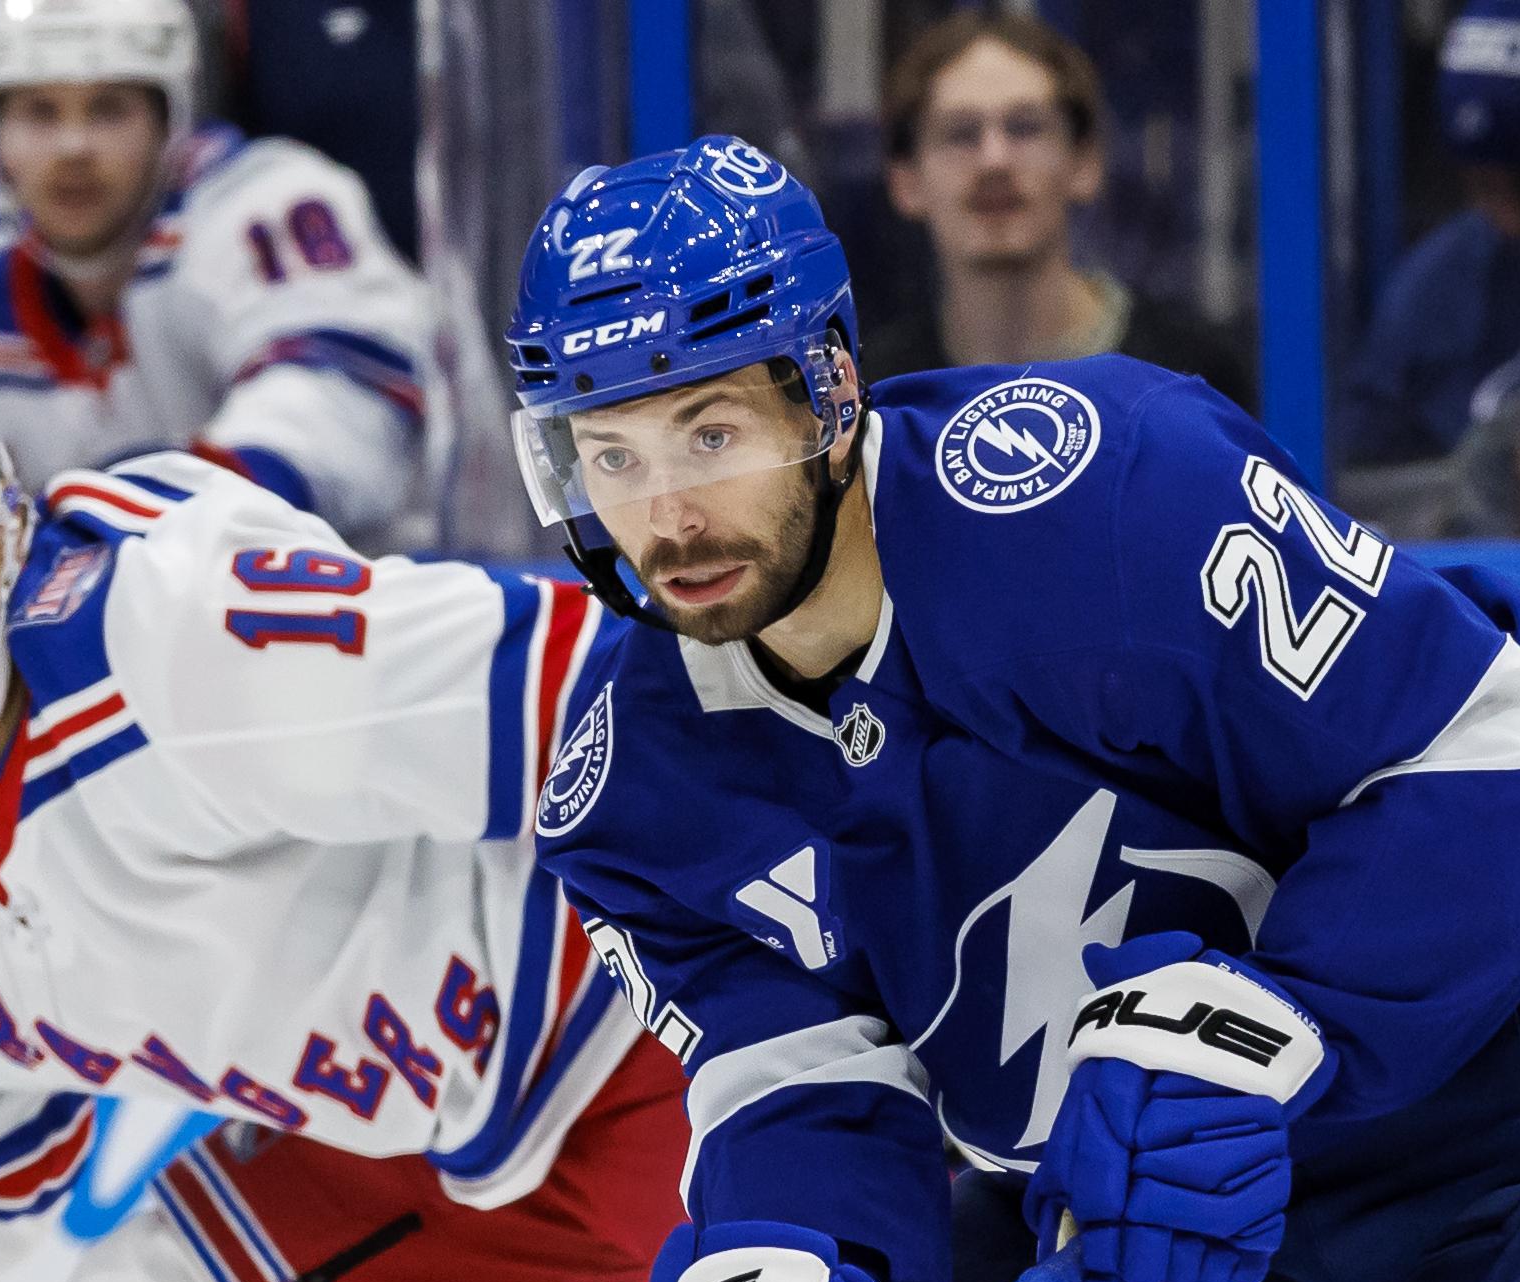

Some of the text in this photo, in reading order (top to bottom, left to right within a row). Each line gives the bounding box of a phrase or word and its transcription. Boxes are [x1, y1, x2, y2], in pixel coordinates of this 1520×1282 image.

[569, 228, 638, 281] 22
[562, 311, 666, 357] CCM
[945, 386, 1069, 502] LIGHTNING BAY TAMPA
[225, 549, 372, 657] 16
[1200, 455, 1395, 702] 22
[853, 719, 869, 758] NHL
[1067, 989, 1293, 1068] RUE
